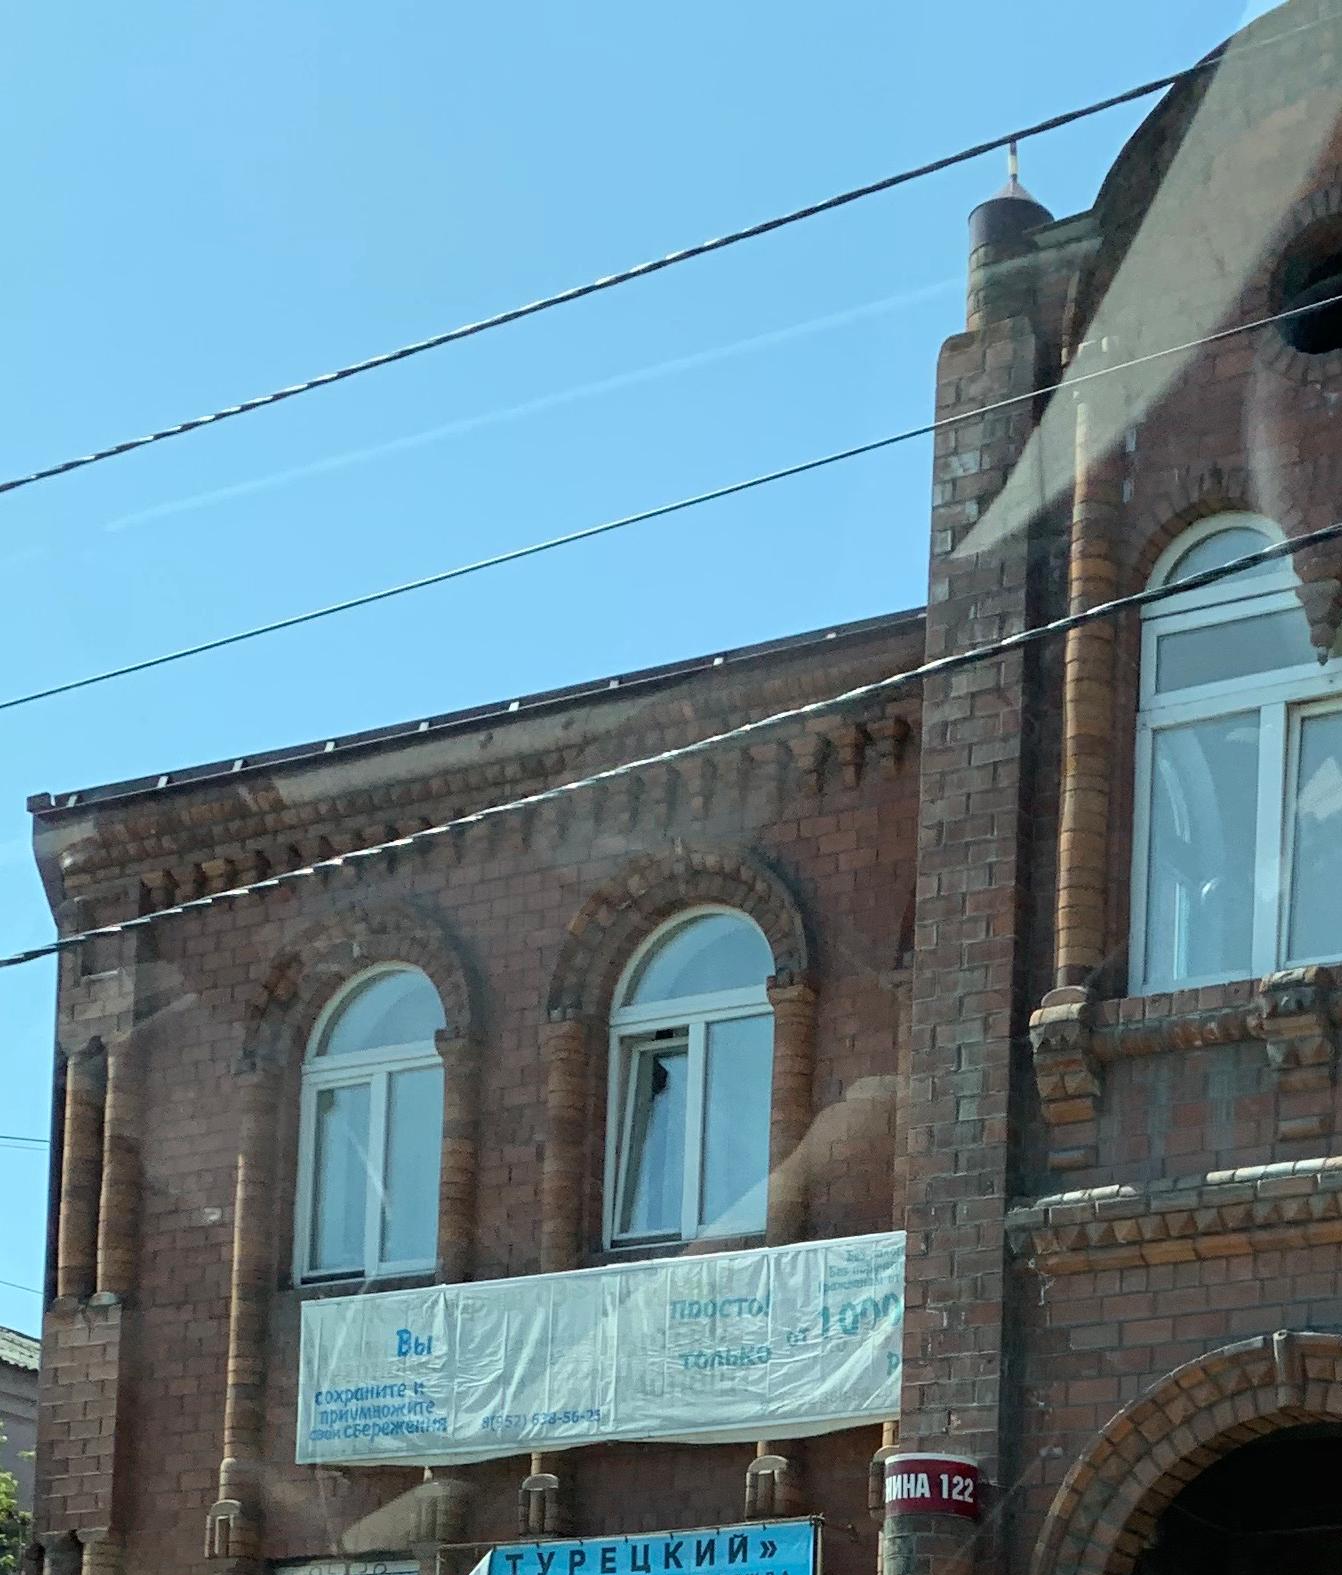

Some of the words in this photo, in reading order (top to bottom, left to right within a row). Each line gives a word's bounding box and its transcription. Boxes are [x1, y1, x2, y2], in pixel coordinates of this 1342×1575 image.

[396, 1328, 433, 1357] Вы
[314, 1382, 406, 1407] сохраните
[320, 1400, 435, 1426] приумножите
[940, 1474, 974, 1503] 122
